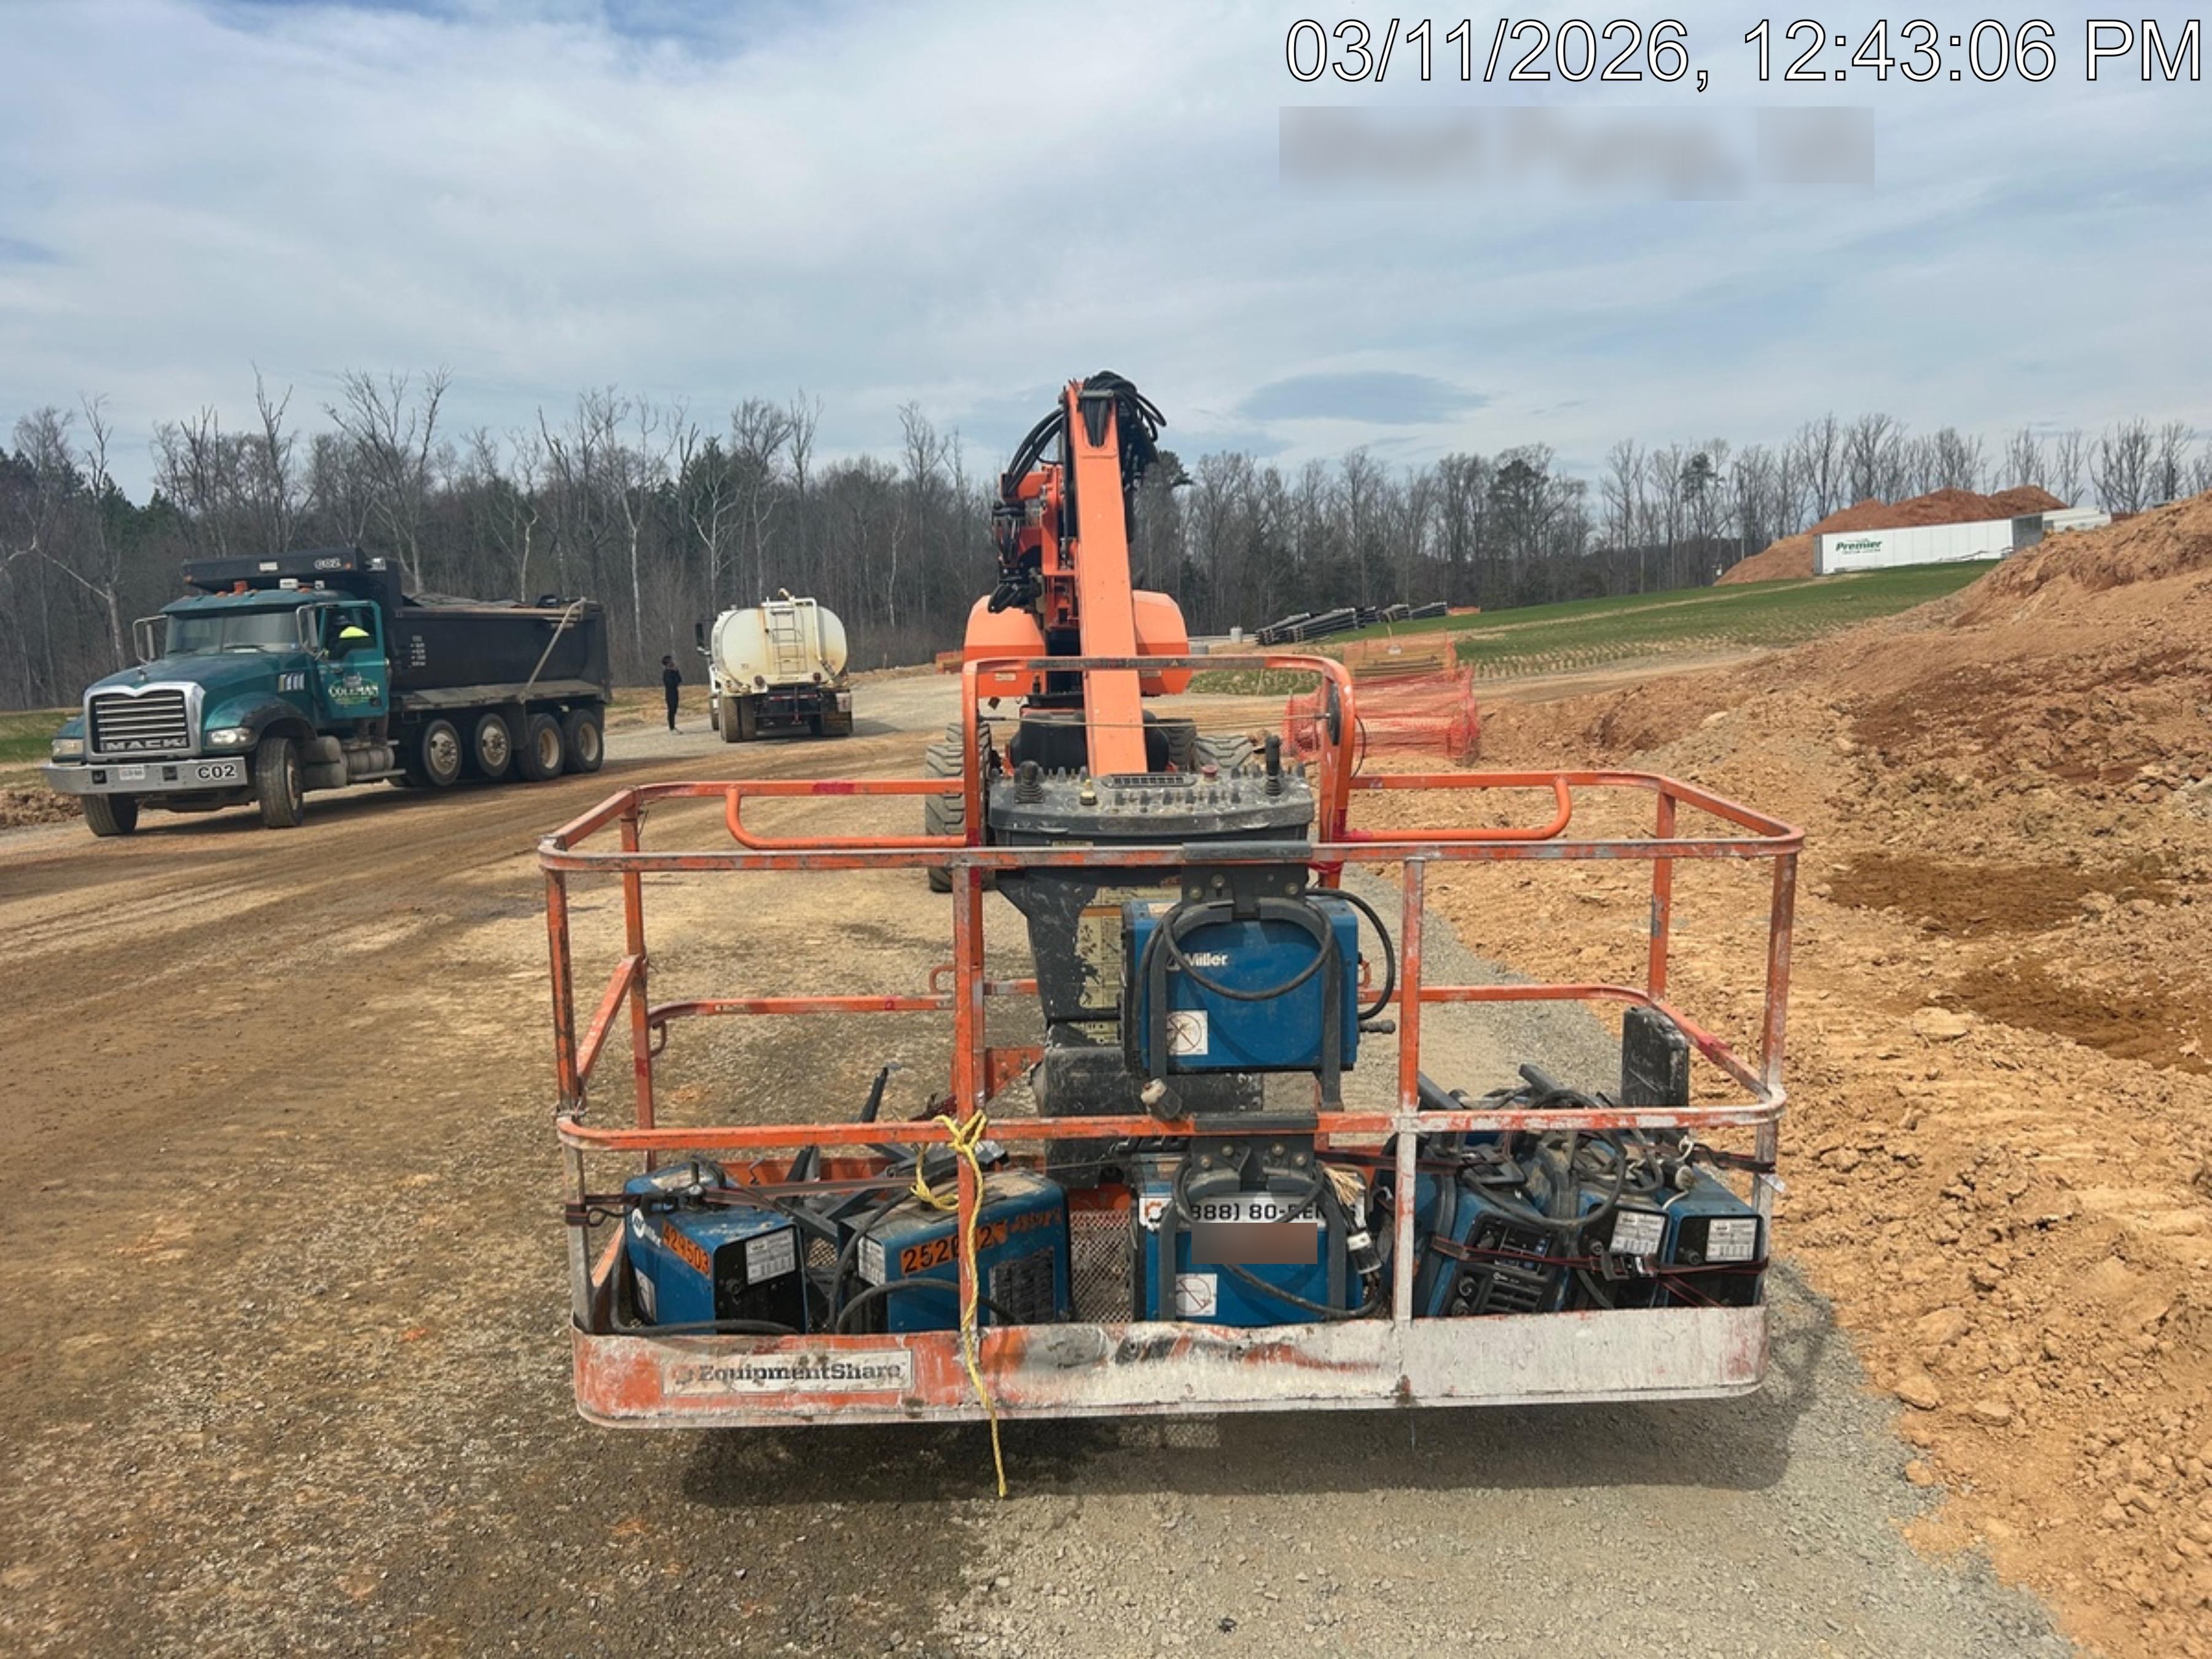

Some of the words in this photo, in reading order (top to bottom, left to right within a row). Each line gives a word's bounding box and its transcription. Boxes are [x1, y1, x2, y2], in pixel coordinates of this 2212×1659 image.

[1835, 540, 1883, 551] Premier
[327, 685, 379, 697] COLEMAN
[106, 737, 187, 751] MACK
[1183, 952, 1229, 967] Miller
[698, 1362, 901, 1384] EquipmentShare
